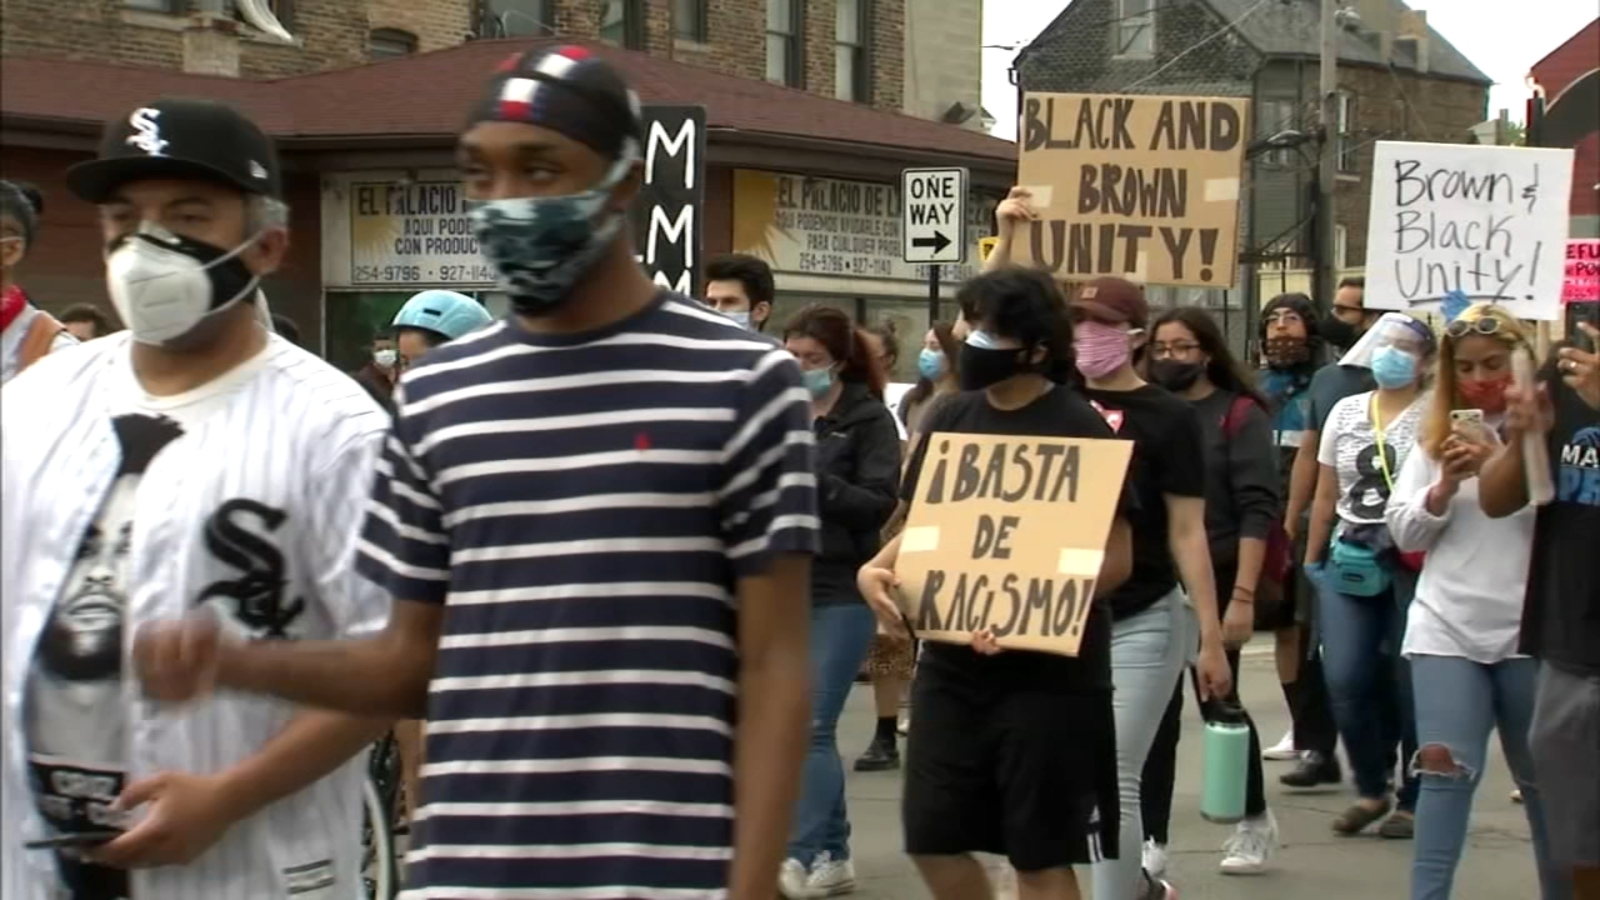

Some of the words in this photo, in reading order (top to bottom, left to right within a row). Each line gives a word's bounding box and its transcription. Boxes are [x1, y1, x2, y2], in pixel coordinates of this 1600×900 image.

[1025, 98, 1135, 152] BLACK
[1150, 100, 1241, 151] AND
[358, 187, 380, 215] EL
[386, 186, 456, 215] PALACIO
[778, 176, 797, 209] EL
[801, 178, 861, 212] PALACIO
[865, 186, 882, 216] DE
[911, 177, 954, 199] ONE
[1078, 163, 1187, 218] BROWN
[1395, 160, 1513, 206] Brown
[1521, 163, 1539, 214] &
[404, 218, 434, 236] AQUI
[910, 203, 954, 225] WAY
[1394, 210, 1514, 258] Black
[395, 238, 421, 254] CON
[1030, 220, 1219, 282] UNITY!
[355, 265, 421, 281] 254-9796
[1395, 241, 1541, 303] Unity!
[925, 440, 1080, 504] ¡BASTA
[972, 514, 1021, 559] DE
[917, 569, 1094, 638] RACISMO!
